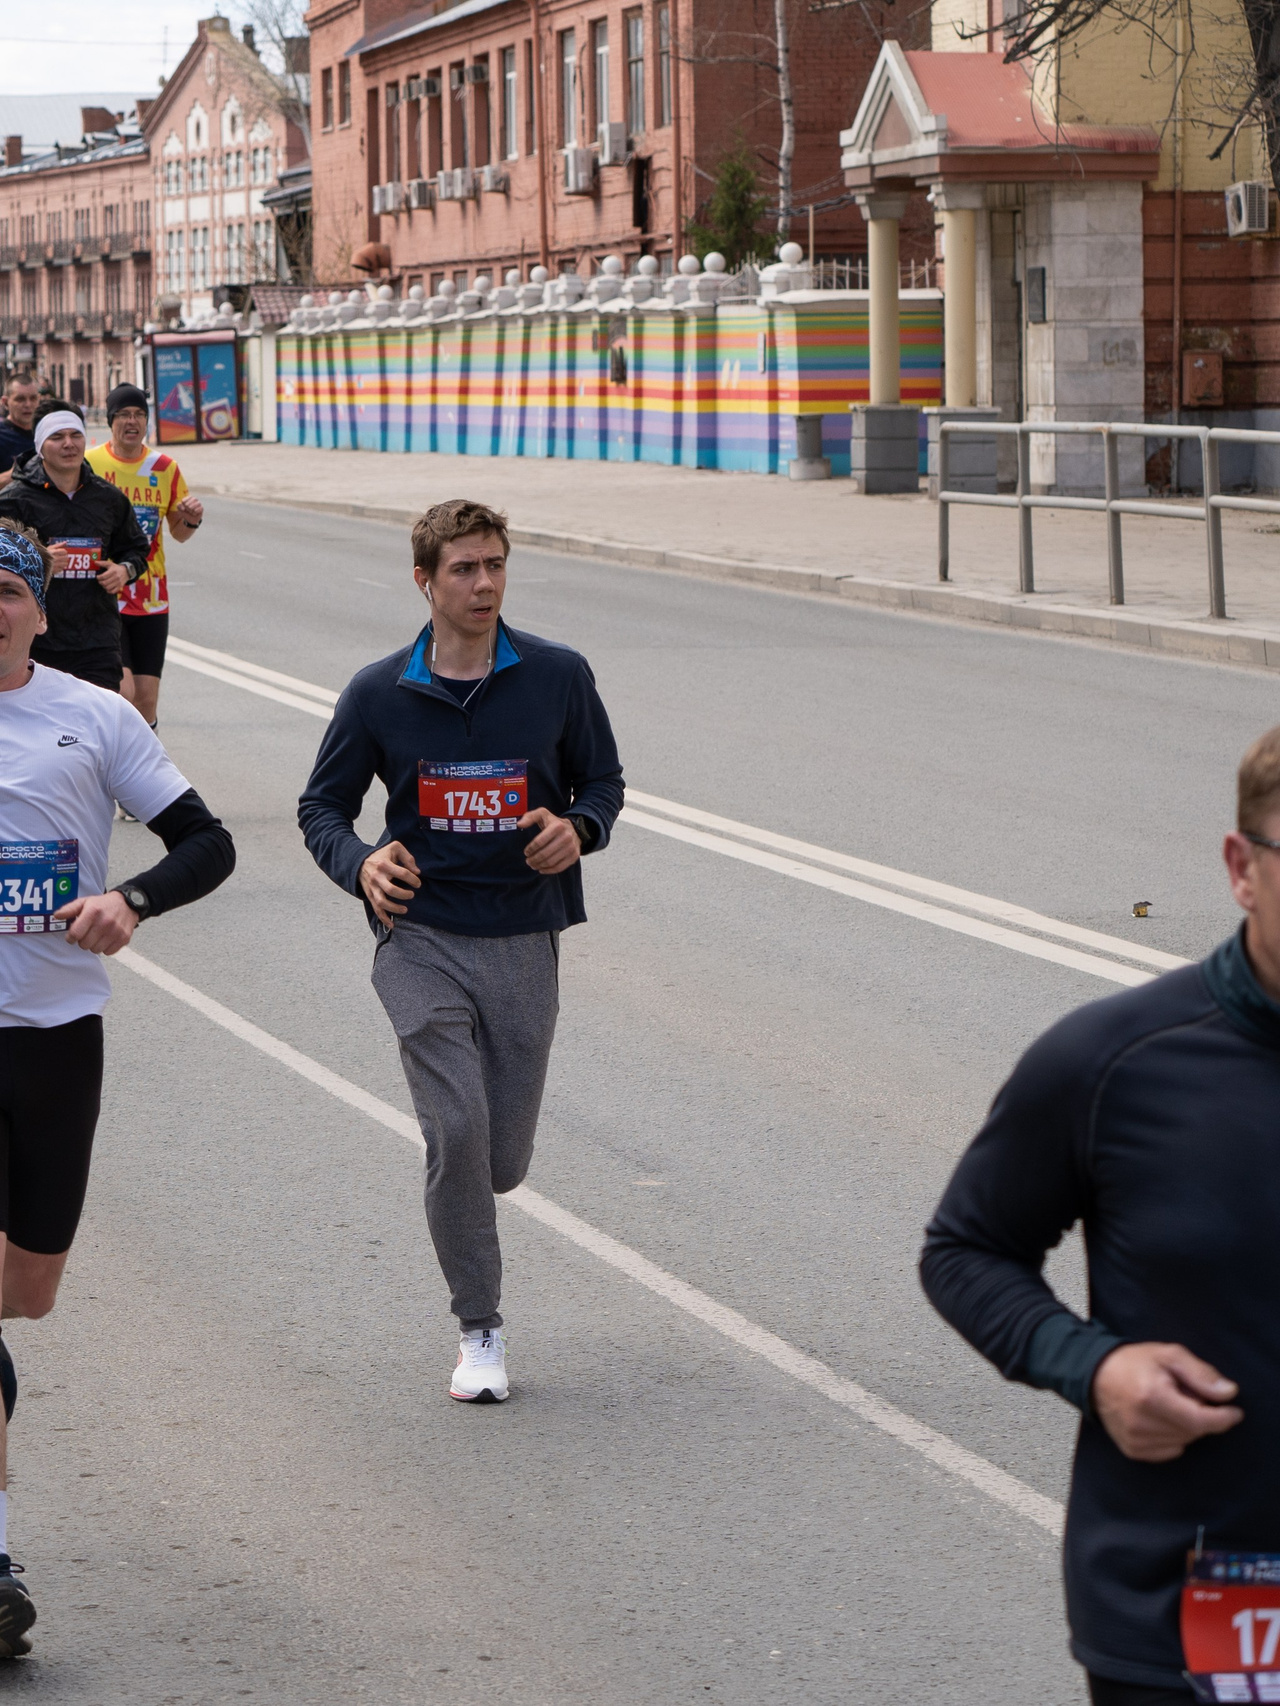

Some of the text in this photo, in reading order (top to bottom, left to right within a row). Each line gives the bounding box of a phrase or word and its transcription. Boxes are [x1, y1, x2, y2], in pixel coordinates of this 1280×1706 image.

[120, 486, 162, 504] MARA
[66, 554, 90, 569] 738
[444, 790, 518, 816] 1743 D
[59, 880, 68, 891] C
[1231, 1608, 1280, 1666] 17
